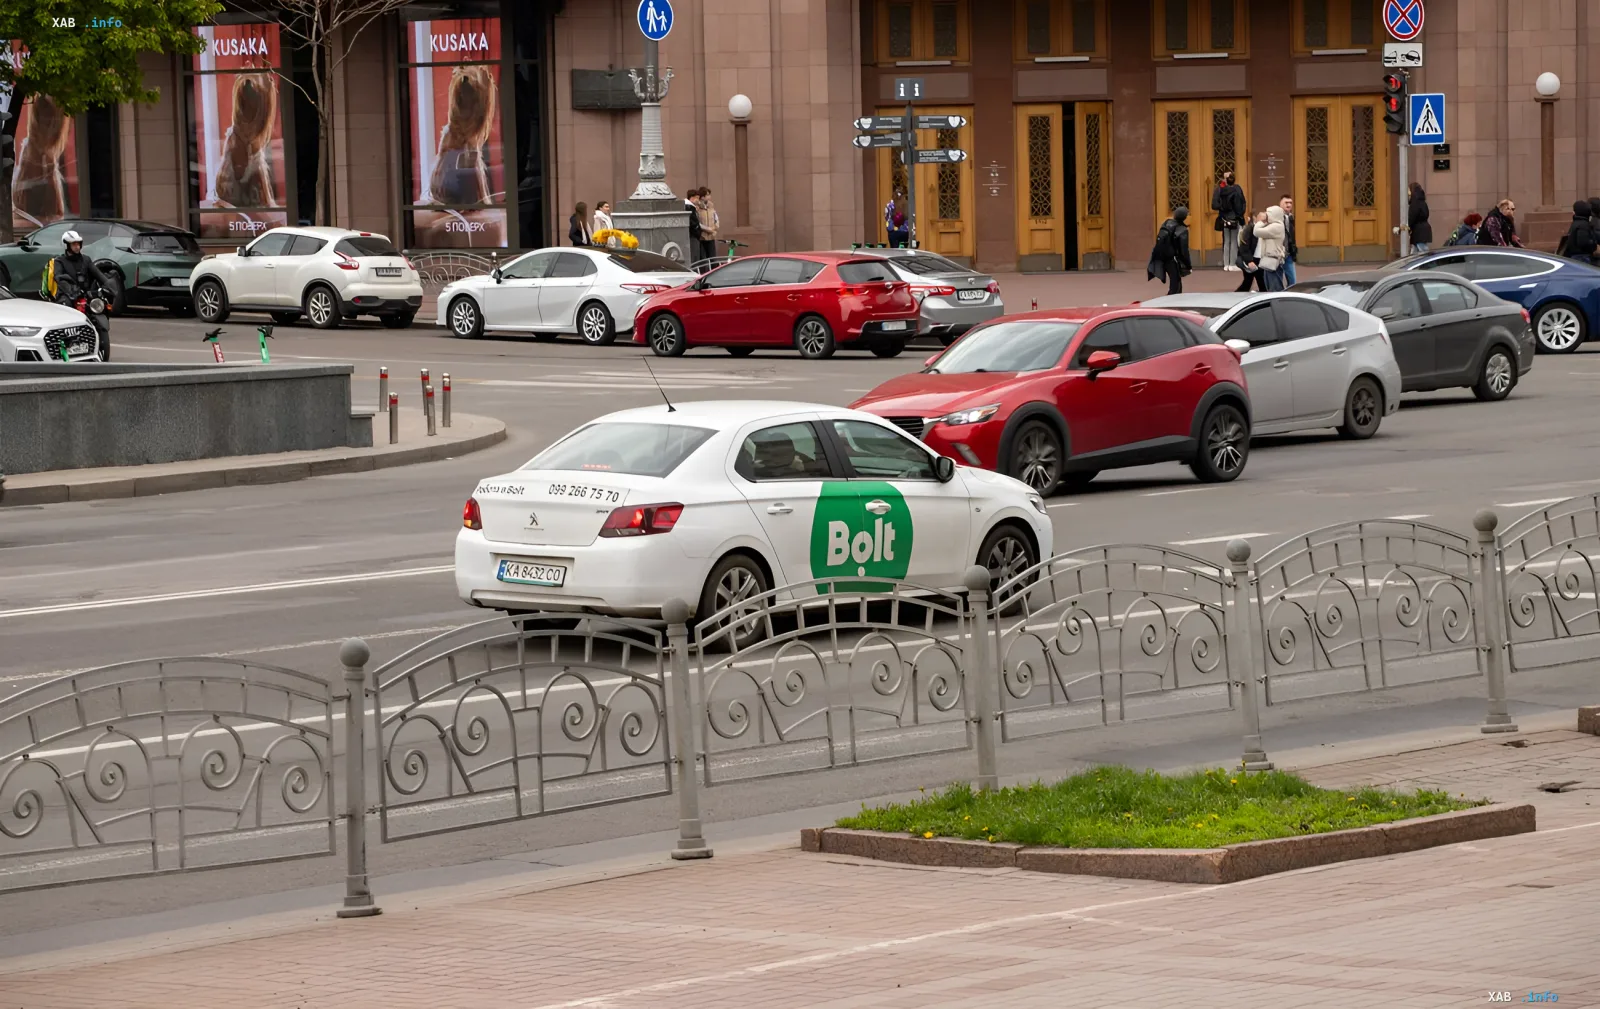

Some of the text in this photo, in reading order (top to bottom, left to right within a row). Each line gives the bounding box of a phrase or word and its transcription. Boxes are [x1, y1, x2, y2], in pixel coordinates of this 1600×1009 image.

[212, 37, 268, 56] KUSAKA
[430, 32, 489, 52] KUSAKA
[228, 221, 235, 231] 5
[445, 222, 451, 232] 5
[548, 484, 620, 502] 099 266 75 70
[826, 517, 896, 567] Bolt
